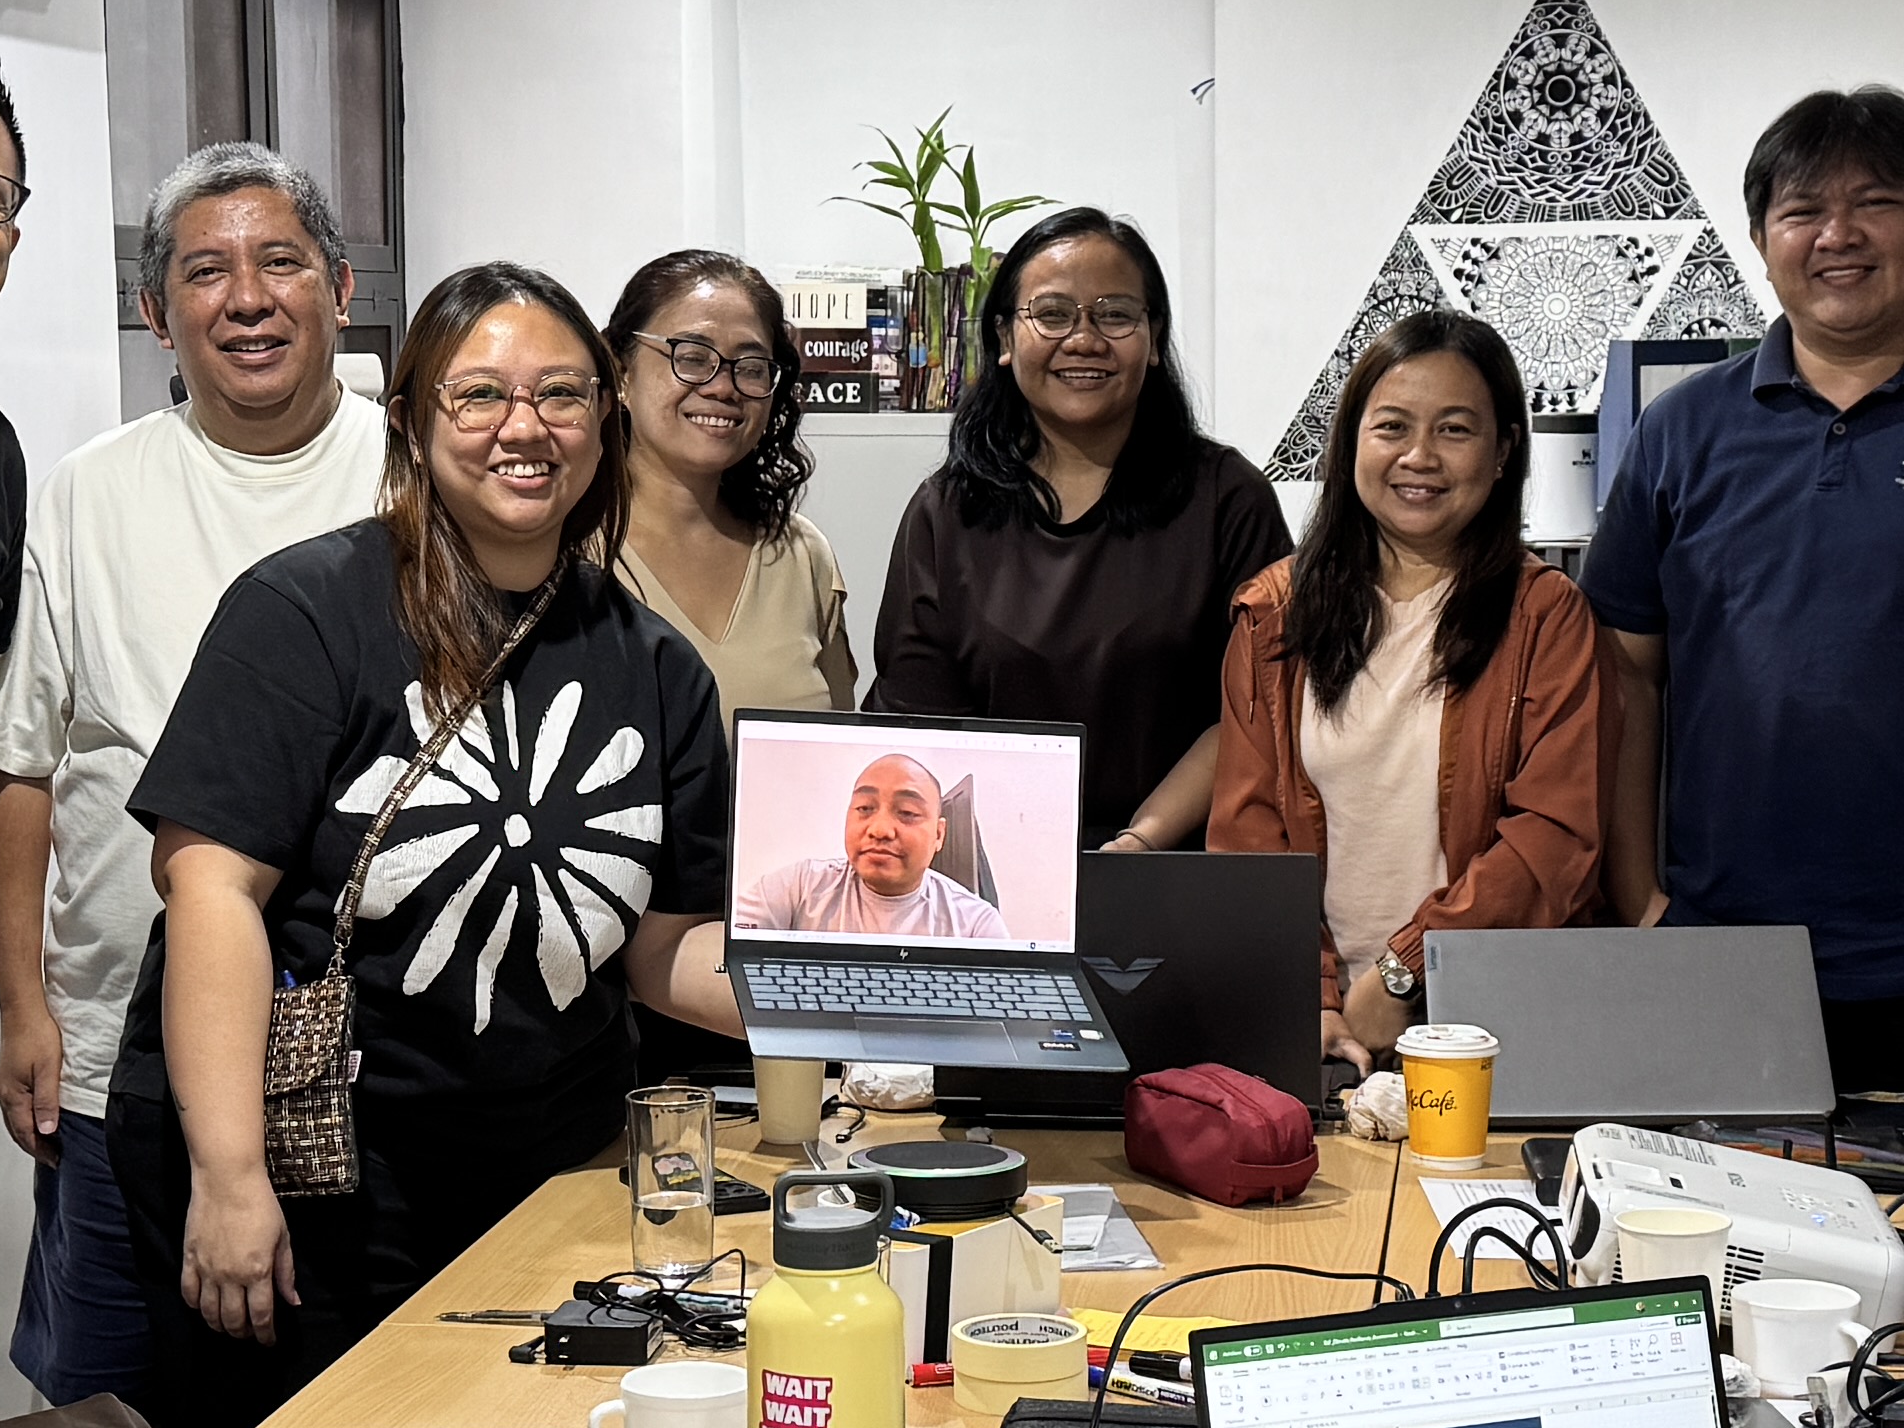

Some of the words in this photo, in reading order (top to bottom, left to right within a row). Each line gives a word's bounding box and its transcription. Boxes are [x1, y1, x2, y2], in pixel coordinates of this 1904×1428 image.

[793, 293, 853, 319] HOPE
[805, 339, 868, 363] courage
[765, 1373, 830, 1400] WAIT
[765, 1400, 830, 1427] WAIT
